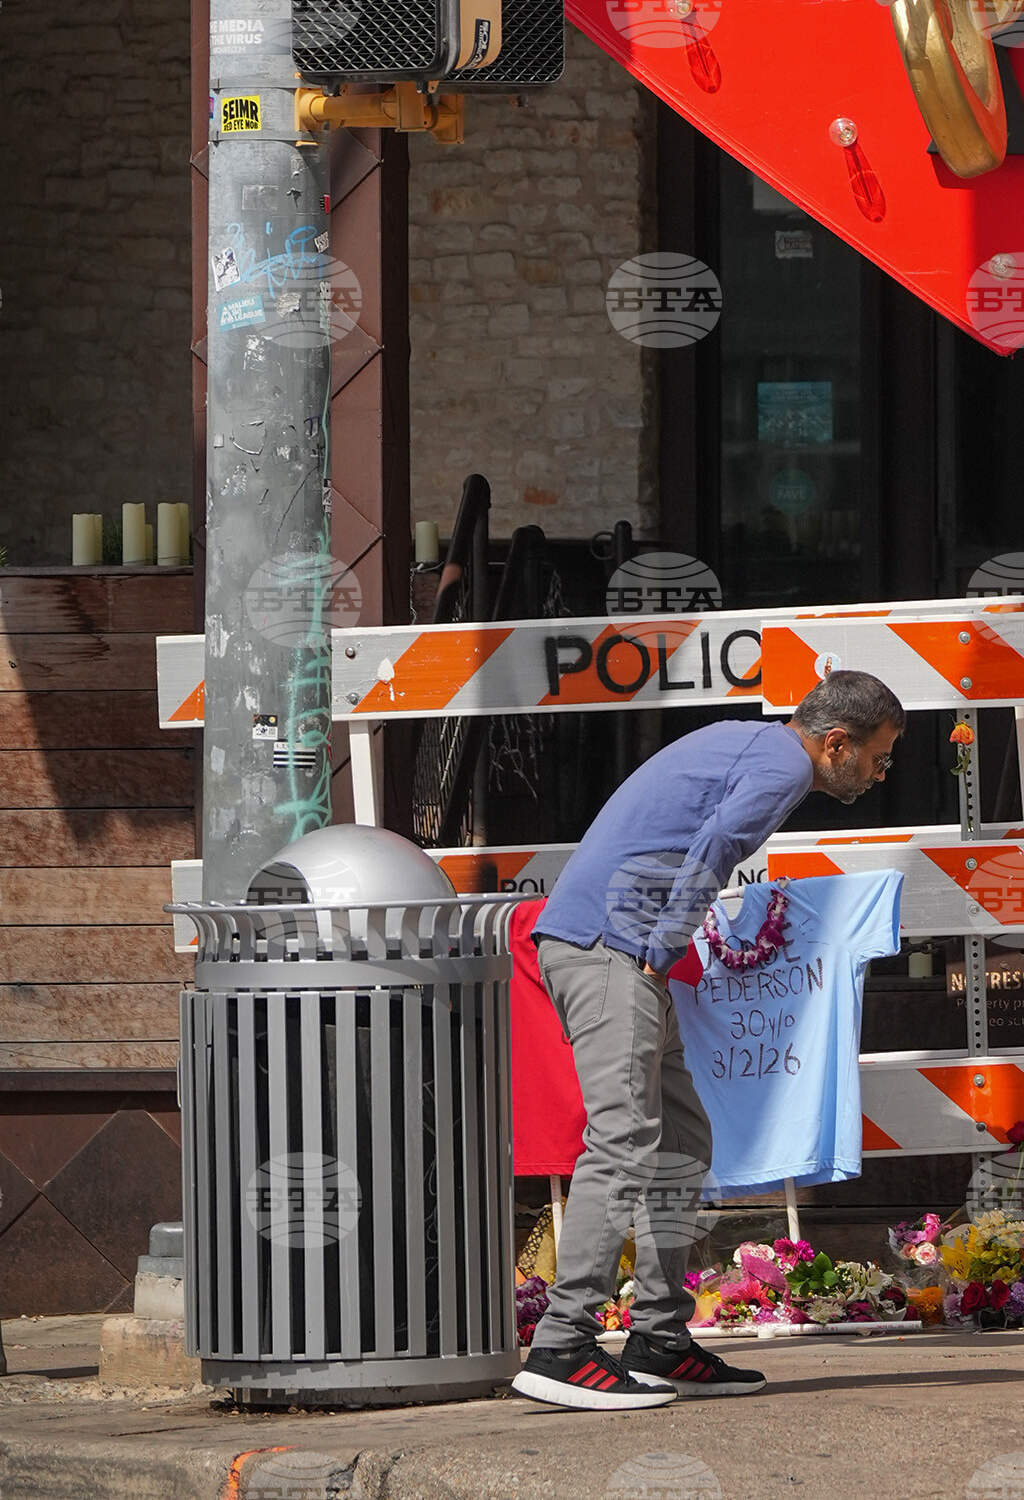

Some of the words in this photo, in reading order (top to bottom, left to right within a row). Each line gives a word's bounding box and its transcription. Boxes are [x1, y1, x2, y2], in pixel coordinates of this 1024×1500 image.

[219, 19, 264, 33] MEDIA
[225, 33, 262, 45] VIRUS
[222, 98, 259, 124] SEIMR
[233, 119, 243, 130] EYE
[544, 629, 762, 696] POLIC
[501, 878, 559, 894] POL
[694, 956, 824, 1005] PEDERSON
[711, 1042, 801, 1080] 3/2/26
